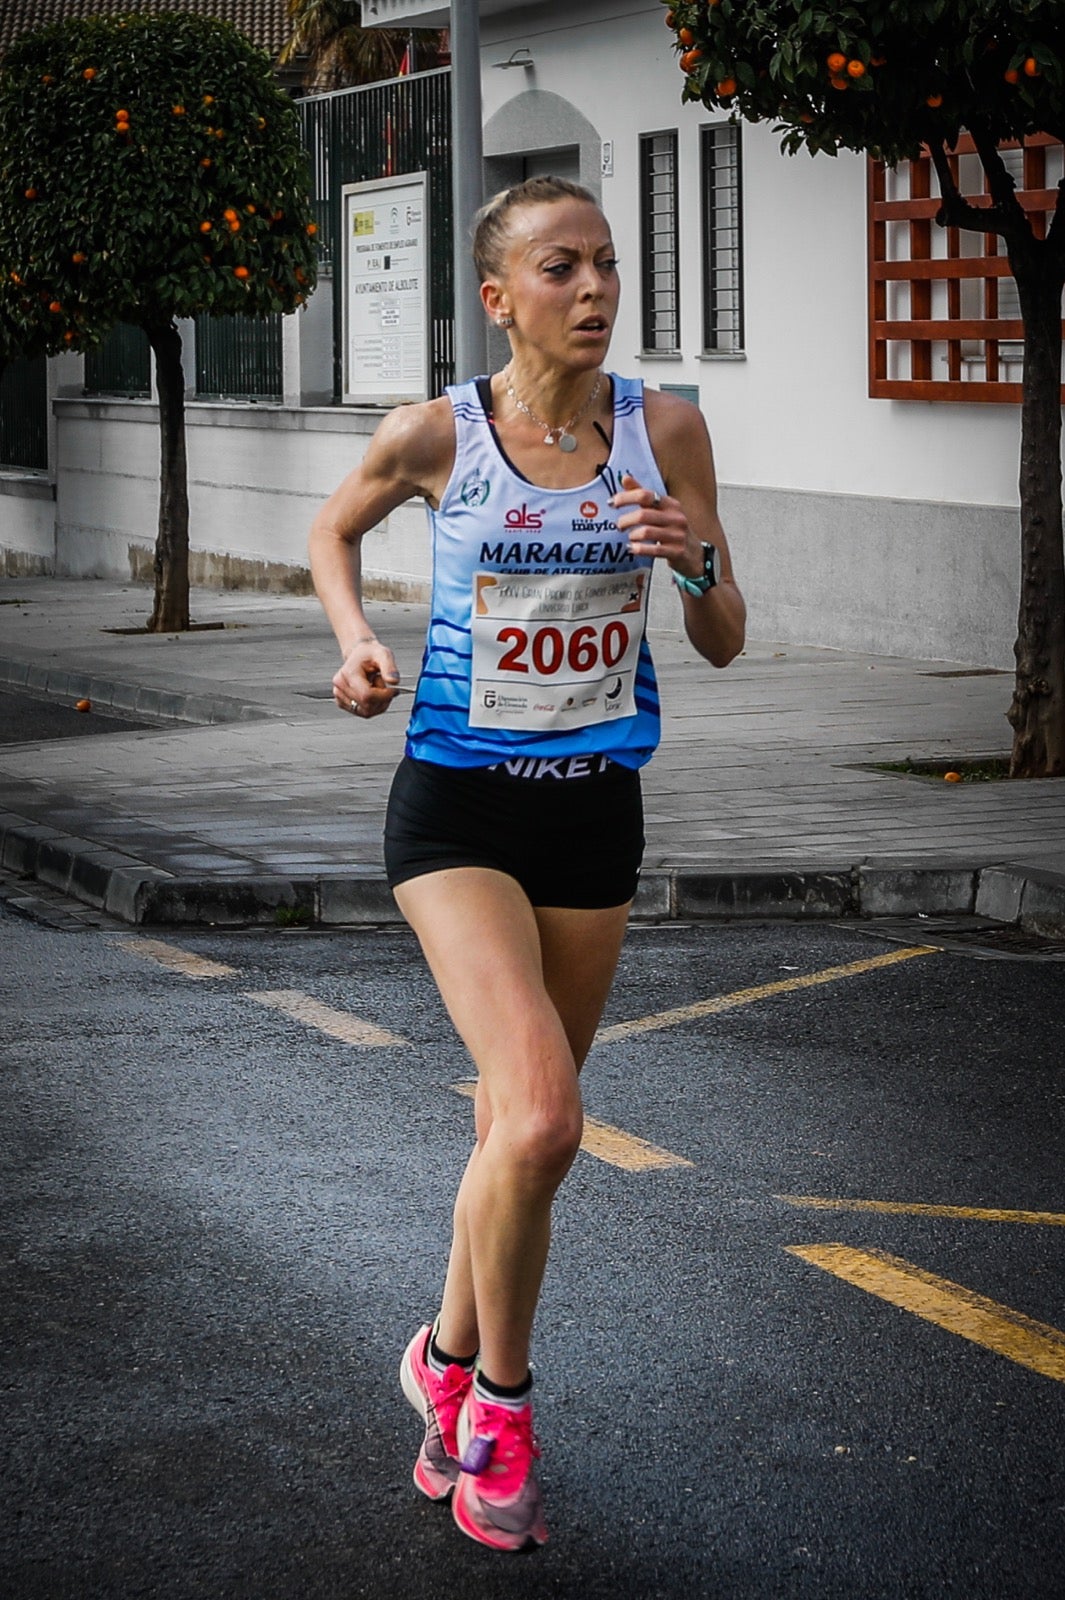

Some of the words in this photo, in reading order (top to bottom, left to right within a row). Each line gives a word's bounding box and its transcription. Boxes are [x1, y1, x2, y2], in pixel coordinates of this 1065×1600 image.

[355, 281, 387, 294] AYUNTAMIENTO
[388, 280, 394, 292] DE
[480, 542, 634, 563] MARACENA
[496, 621, 629, 675] 2060
